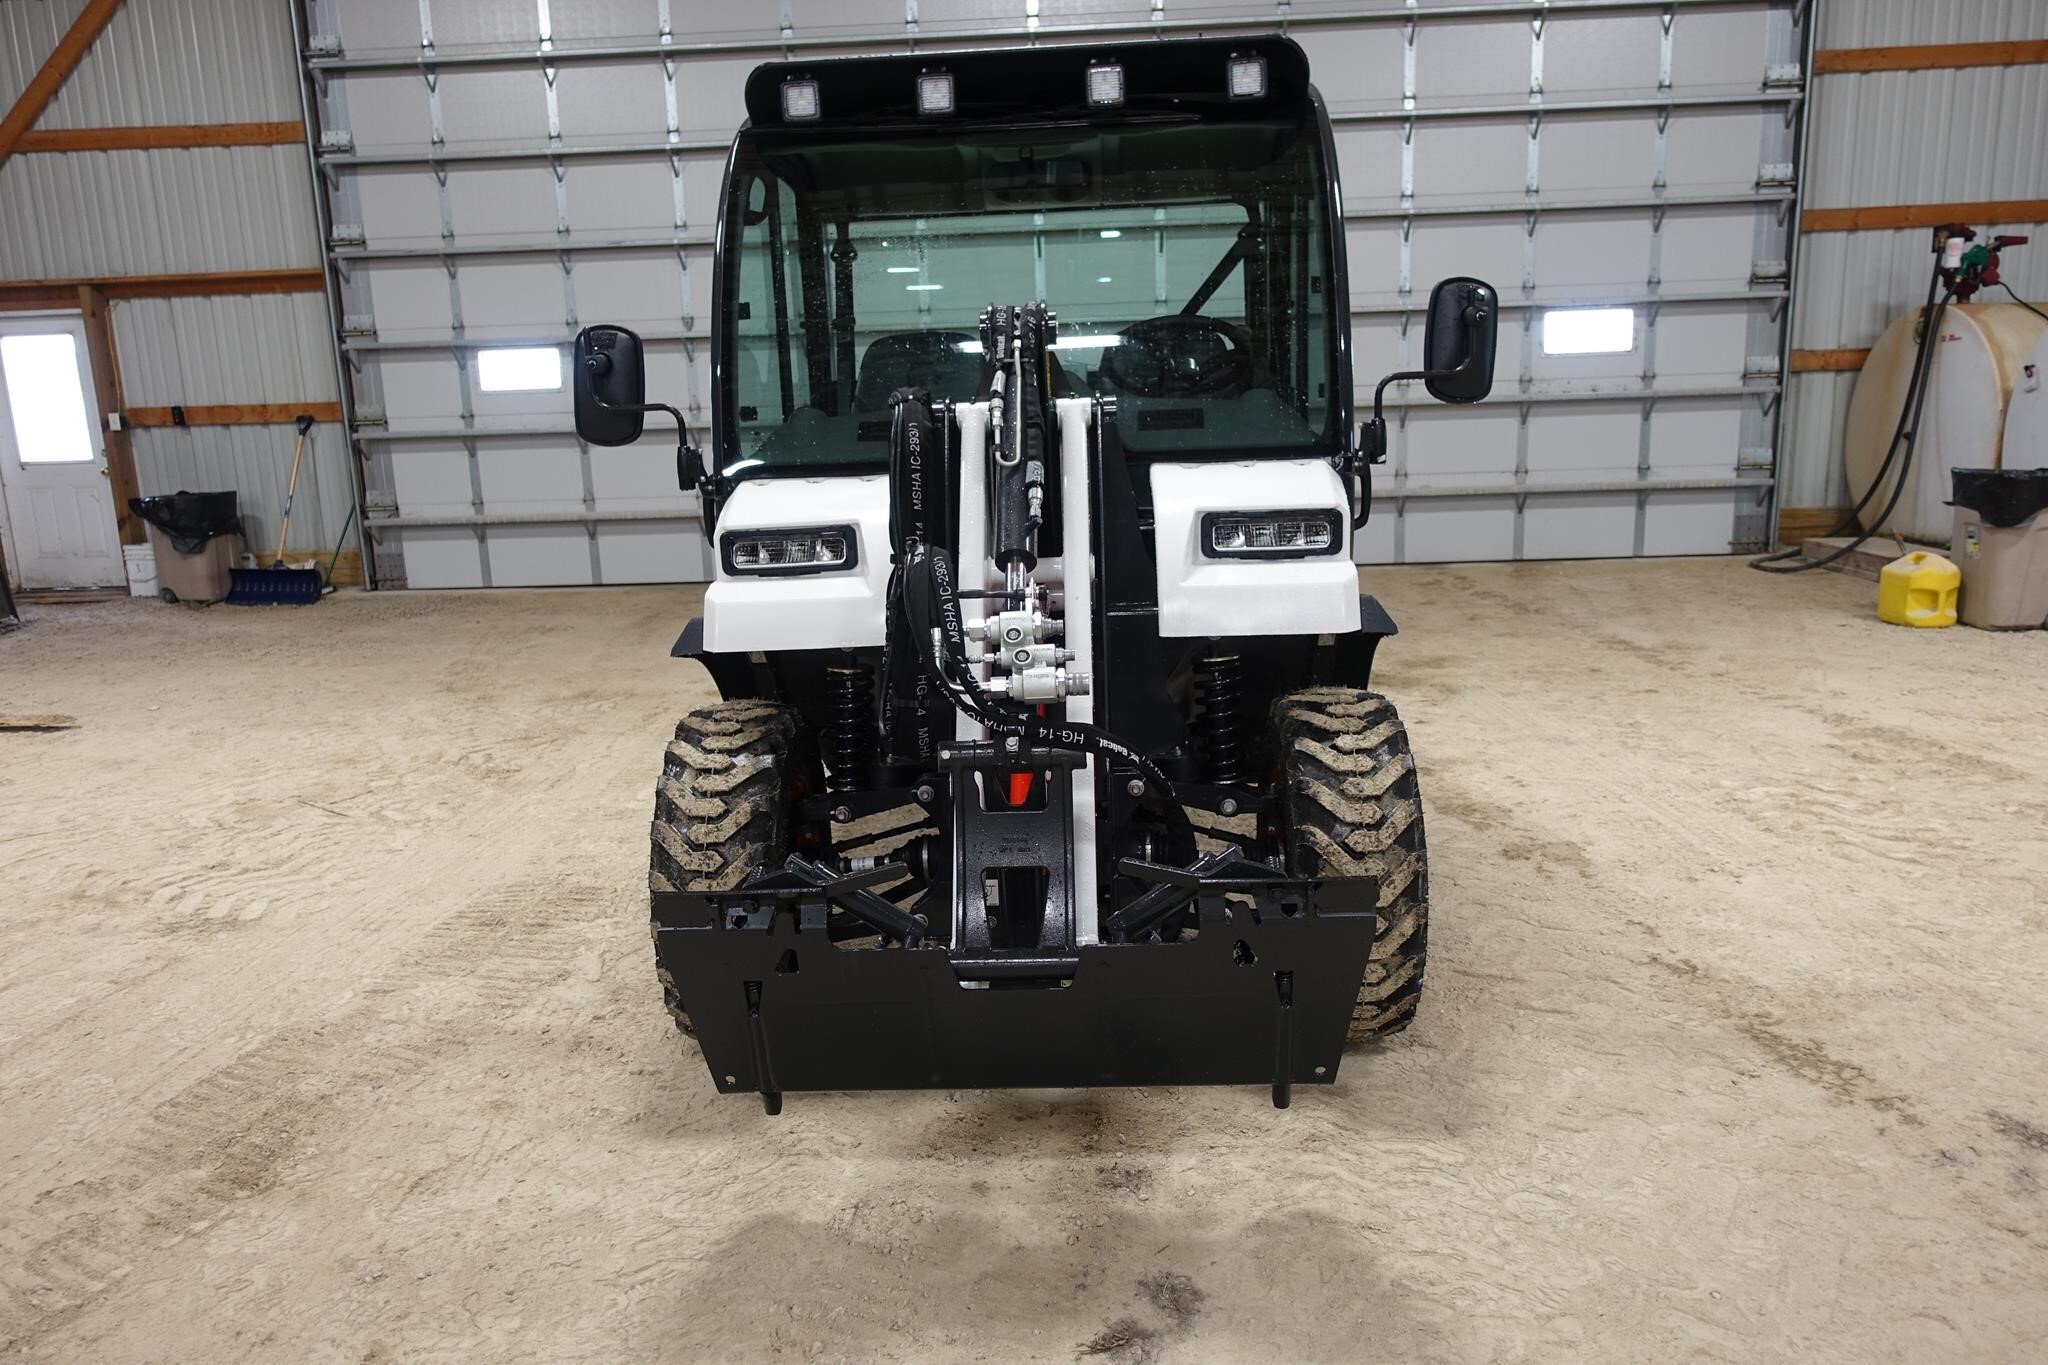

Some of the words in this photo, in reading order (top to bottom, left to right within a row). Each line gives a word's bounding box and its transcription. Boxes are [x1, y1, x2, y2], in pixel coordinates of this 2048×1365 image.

[908, 421, 922, 470] IC-293/1
[912, 472, 922, 511] MSHA
[933, 556, 953, 600] IC-293/1
[942, 601, 961, 643] MSHA
[1039, 726, 1085, 745] HG-14
[1099, 738, 1128, 757] Bobcat
